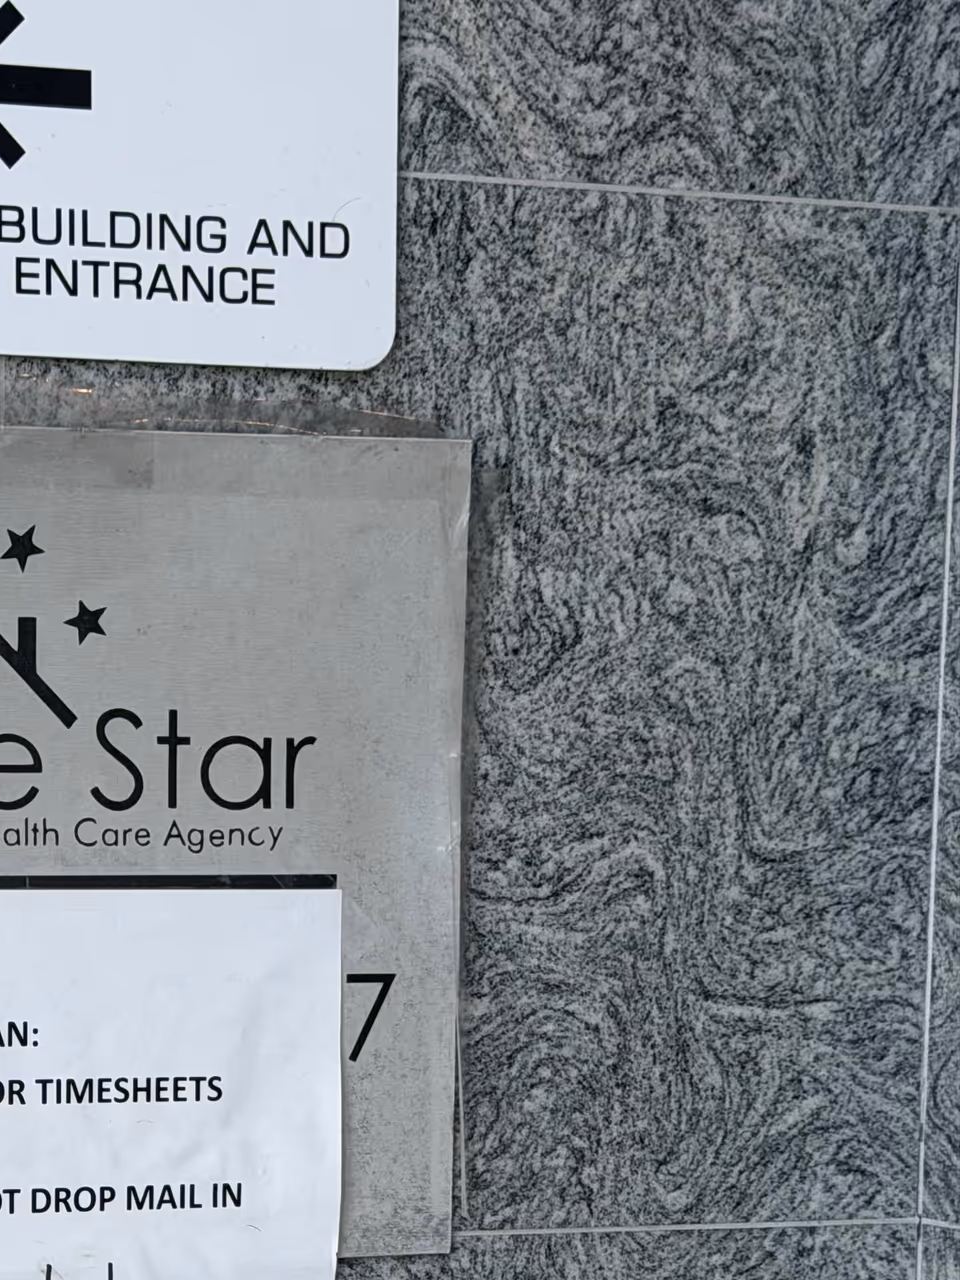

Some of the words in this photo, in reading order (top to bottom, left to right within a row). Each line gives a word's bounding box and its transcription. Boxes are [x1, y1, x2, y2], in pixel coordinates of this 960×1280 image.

[247, 219, 349, 258] AND
[16, 257, 275, 305] ENTRANCE
[91, 708, 317, 811] Star
[74, 818, 150, 846] Care
[164, 820, 283, 853] Agency
[35, 1076, 222, 1104] TIMESHEETS
[32, 1187, 115, 1213] DROP
[127, 1184, 202, 1210] MAIL
[213, 1183, 241, 1207] IN
